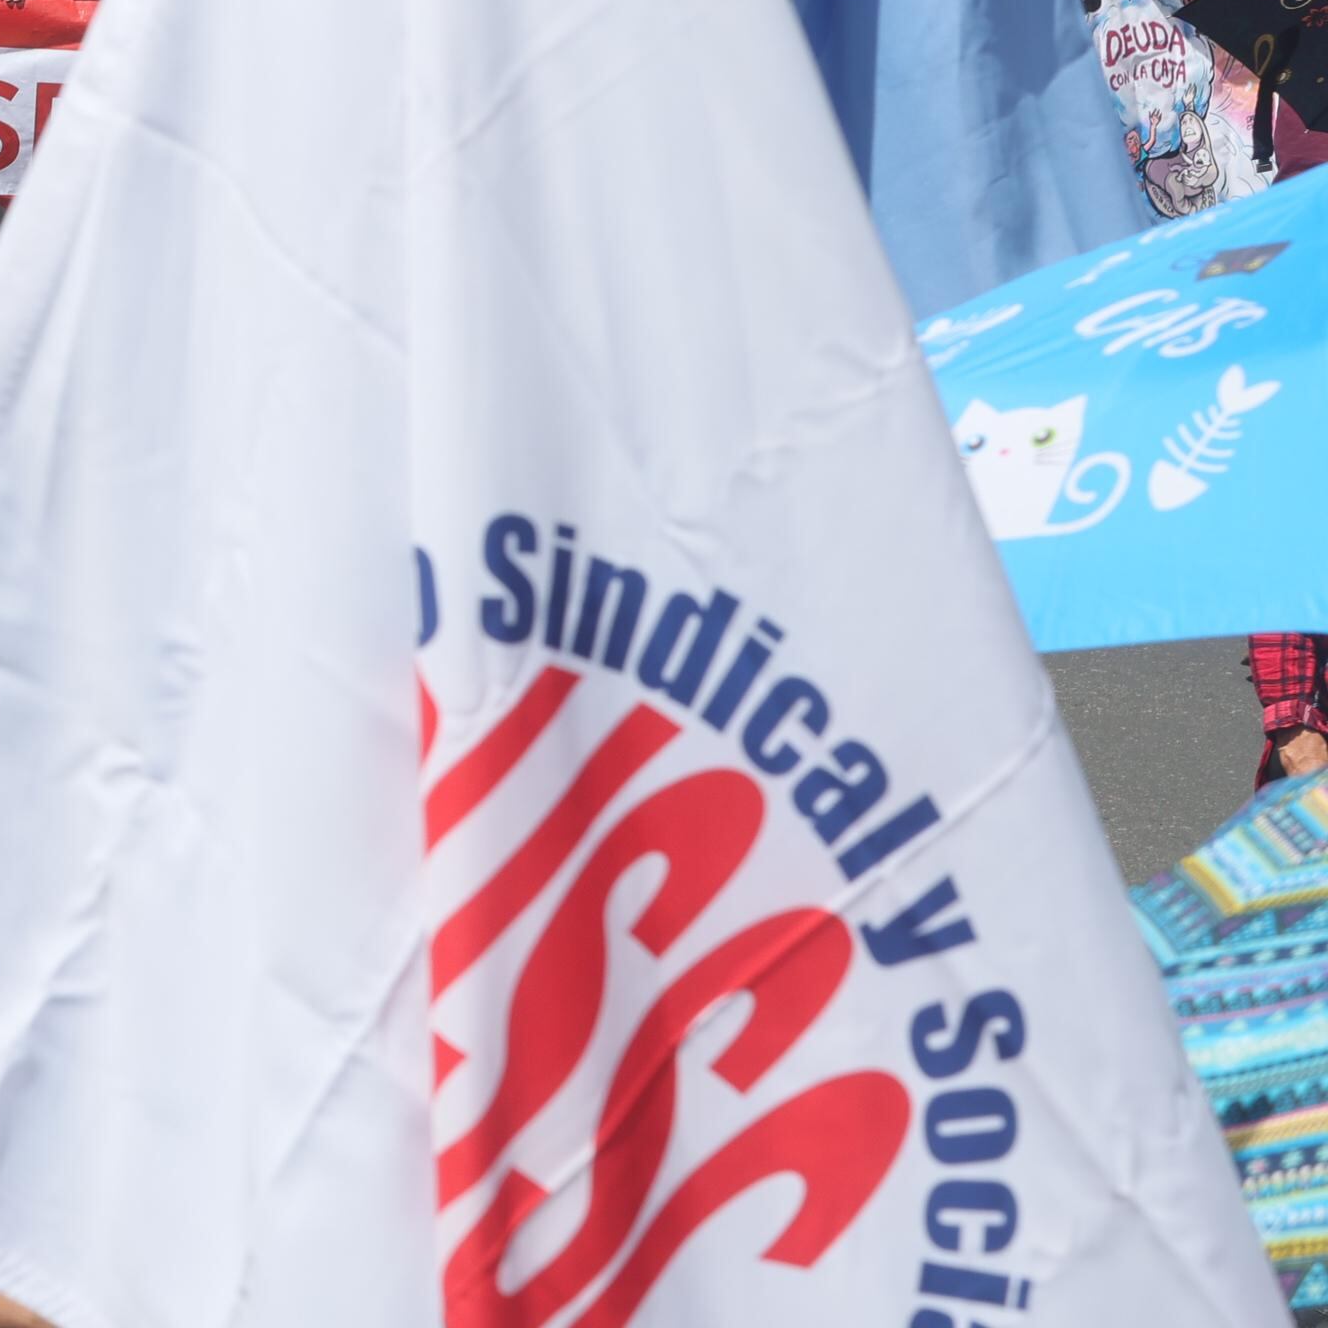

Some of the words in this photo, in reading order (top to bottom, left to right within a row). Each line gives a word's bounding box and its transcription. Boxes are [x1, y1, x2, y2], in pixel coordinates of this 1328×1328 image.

[1105, 21, 1186, 68] DEUDA
[1110, 71, 1130, 91] CON
[1133, 65, 1148, 81] LA
[1151, 58, 1186, 89] CAJA
[480, 513, 943, 885] Sindical
[859, 875, 978, 970] y
[909, 989, 1032, 1328] Soci
